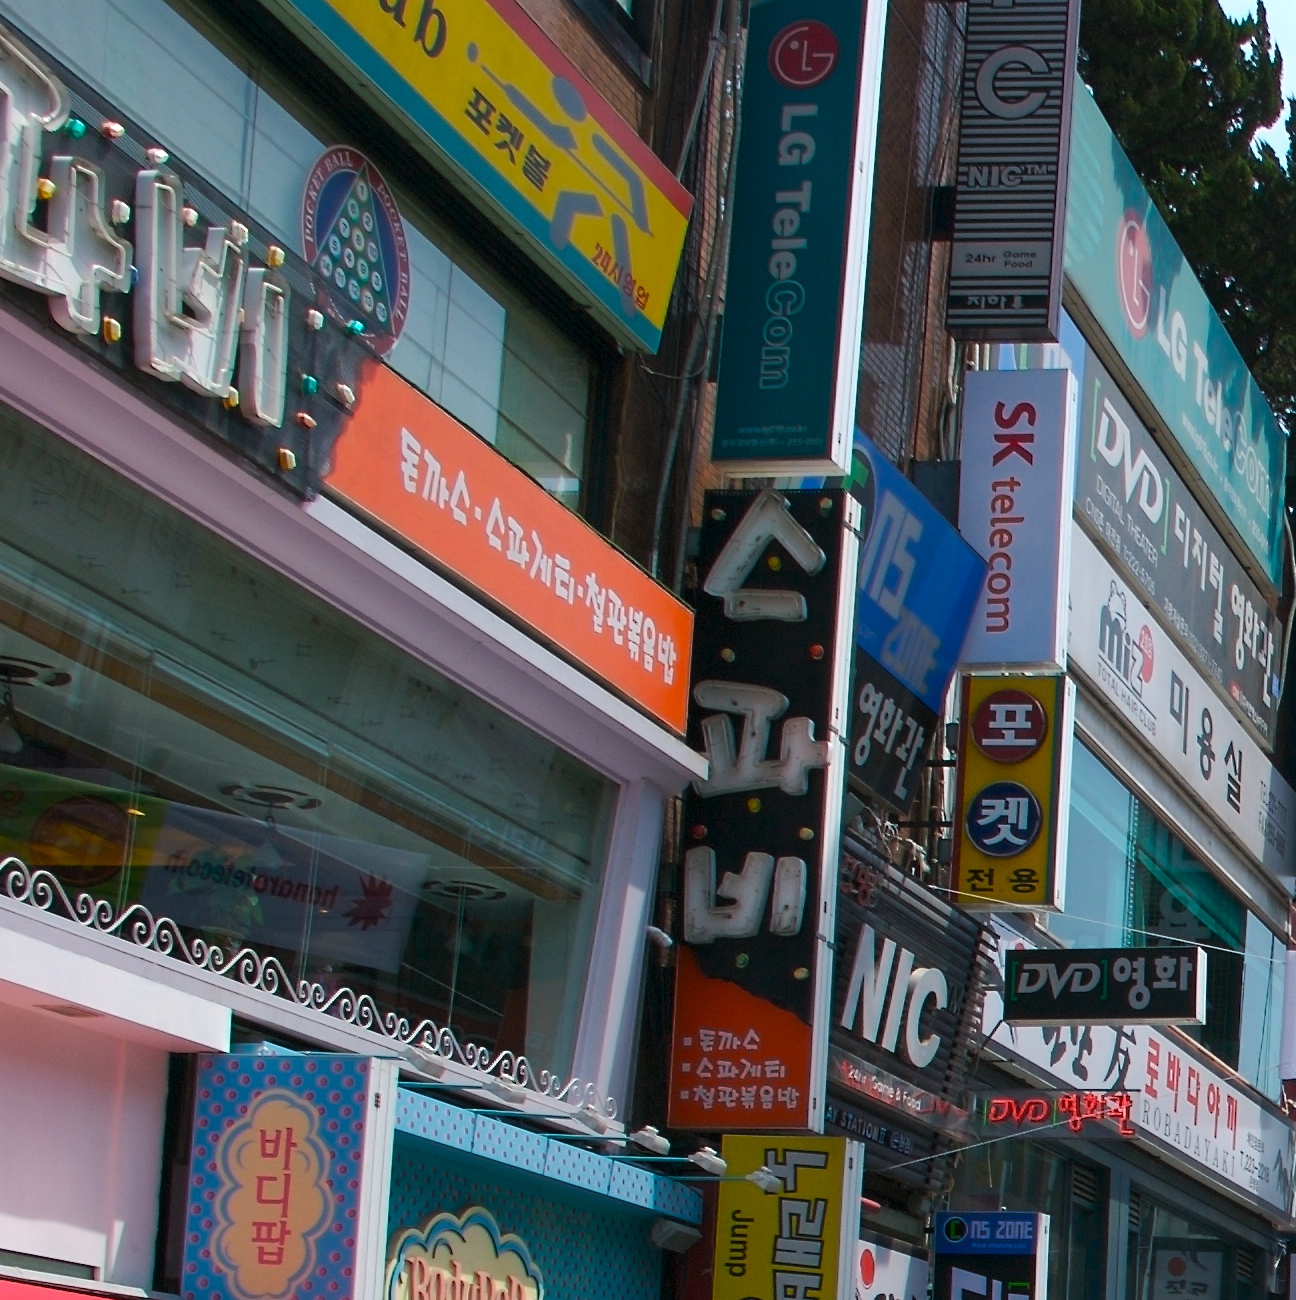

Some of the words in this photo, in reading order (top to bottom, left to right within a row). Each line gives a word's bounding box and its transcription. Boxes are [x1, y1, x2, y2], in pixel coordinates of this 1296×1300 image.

[465, 87, 551, 192] 포켓볼
[778, 102, 819, 166] LG
[594, 240, 651, 311] 24시영업
[965, 252, 997, 265] 24hr
[1002, 250, 1037, 260] Game
[1003, 260, 1033, 269] Food
[1155, 285, 1187, 382] LG
[991, 401, 1037, 468] SK
[1096, 397, 1164, 524] DVD
[400, 425, 470, 526] 돈까스
[485, 496, 574, 605] 스파게티
[586, 570, 677, 686] 철판볶음밥
[985, 477, 1025, 634] telecom
[1095, 473, 1126, 534] DIGITAL
[1125, 512, 1159, 569] THEATER
[1173, 502, 1224, 645] 디지털
[1230, 583, 1275, 710] 영화관
[1097, 660, 1121, 702] TOTAL
[1119, 686, 1138, 717] HAIR
[1137, 704, 1157, 738] CLUB
[853, 682, 926, 801] 영화관
[976, 702, 1031, 848] 포켓
[1169, 668, 1243, 816] 미용실
[966, 866, 1041, 896] 전용
[840, 922, 948, 1069] NIC
[1017, 962, 1101, 1000] DVD
[1112, 955, 1194, 1011] 영화
[695, 1058, 786, 1081] 스파게티
[699, 1028, 760, 1052] 돈까스
[692, 1084, 800, 1113] 철판볶음밥
[840, 1111, 879, 1141] STATION
[902, 1091, 922, 1111] Food
[987, 1094, 1048, 1128] DVD
[1057, 1091, 1136, 1136] 영화관
[1144, 1036, 1240, 1152] 로바다야끼
[1141, 1099, 1237, 1178] ROBADAYAKI
[250, 1125, 298, 1267] 바디팝
[725, 1209, 755, 1278] Jump
